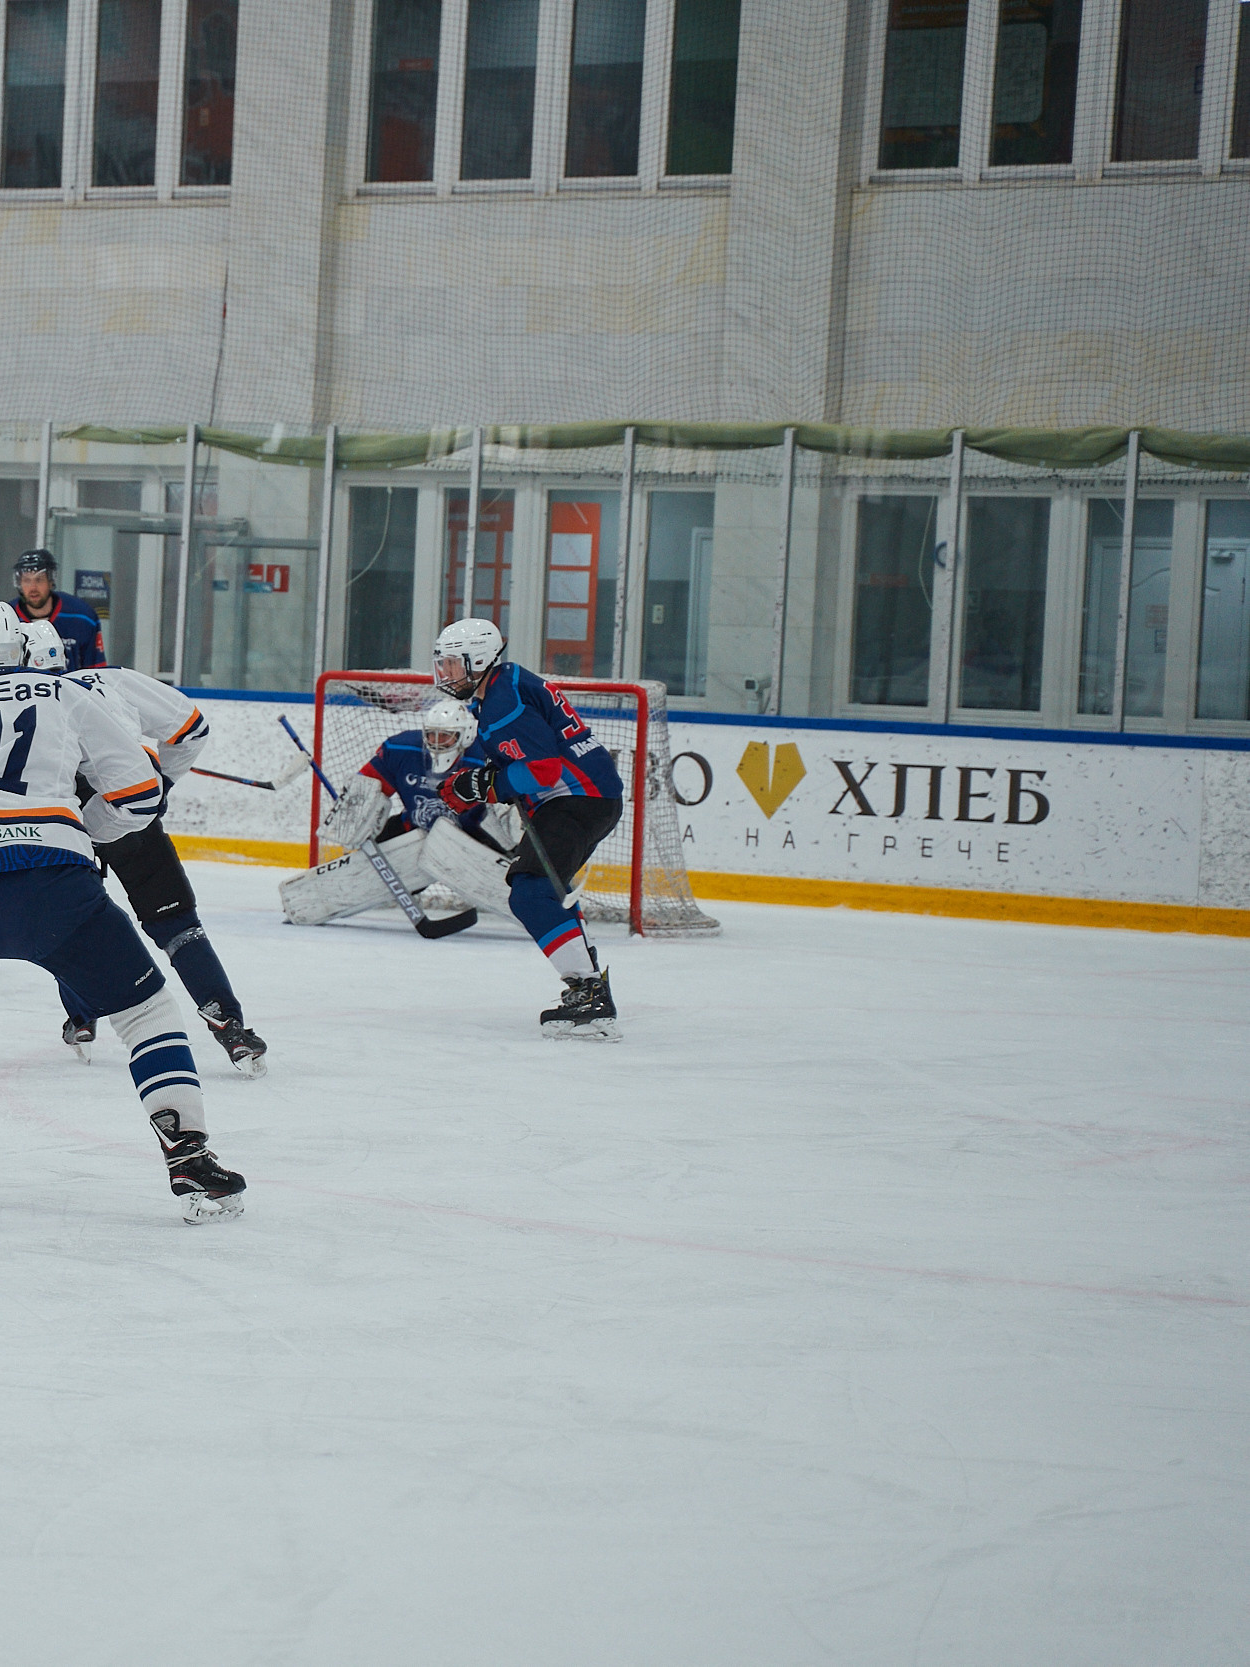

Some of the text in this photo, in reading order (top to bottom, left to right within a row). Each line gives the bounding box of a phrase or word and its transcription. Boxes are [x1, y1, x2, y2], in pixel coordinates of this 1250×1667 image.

[499, 738, 526, 760] 31
[828, 760, 1050, 826] ХЛЕБ
[745, 827, 796, 850] НА
[847, 833, 1010, 863] ГРЕЧЕ
[316, 856, 351, 875] CCM
